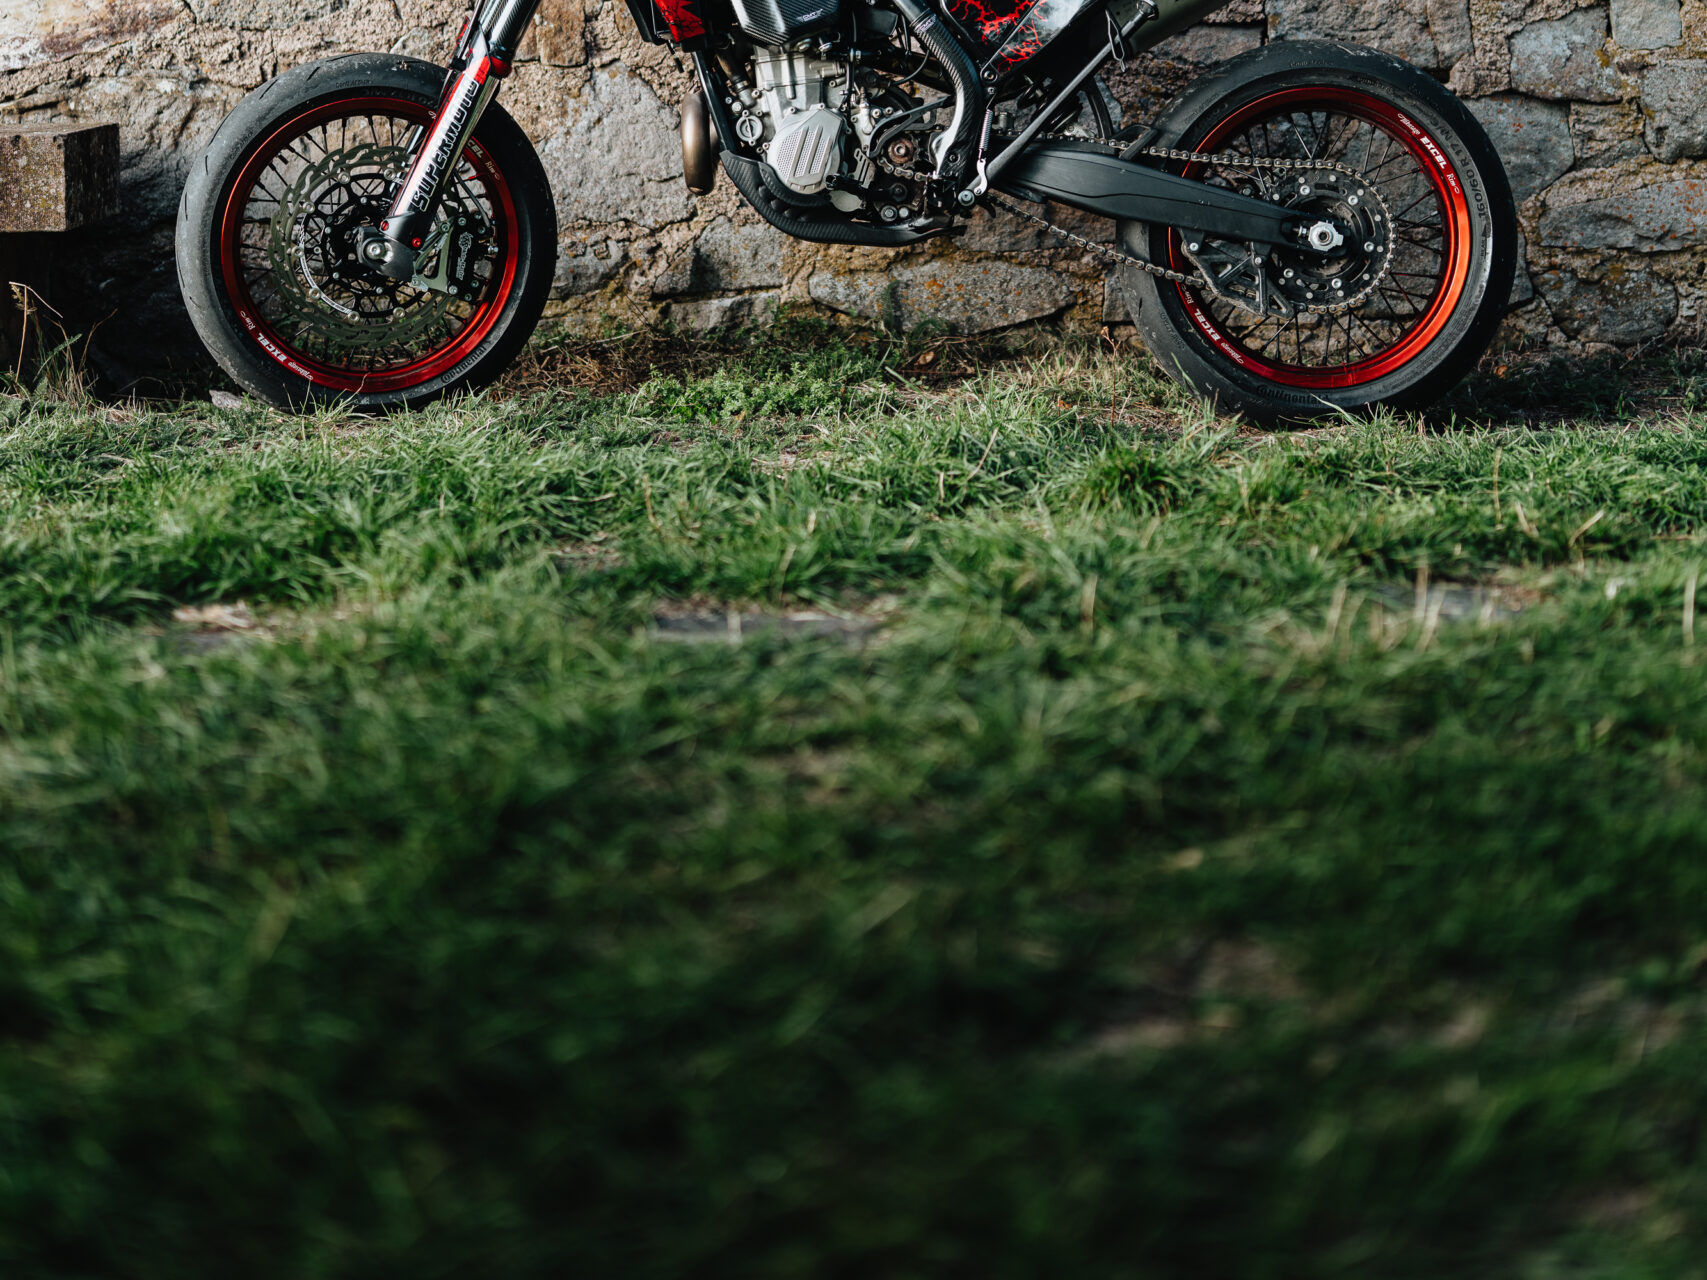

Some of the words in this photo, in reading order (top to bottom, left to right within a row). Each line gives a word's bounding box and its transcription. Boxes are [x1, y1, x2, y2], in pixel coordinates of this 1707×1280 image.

[411, 79, 480, 213] SUPERMOTO
[467, 140, 484, 158] CEL
[1420, 136, 1447, 169] EXCEL
[1466, 170, 1486, 218] 160/60
[1194, 309, 1221, 341] EXCEL
[257, 332, 288, 362] EXCEL
